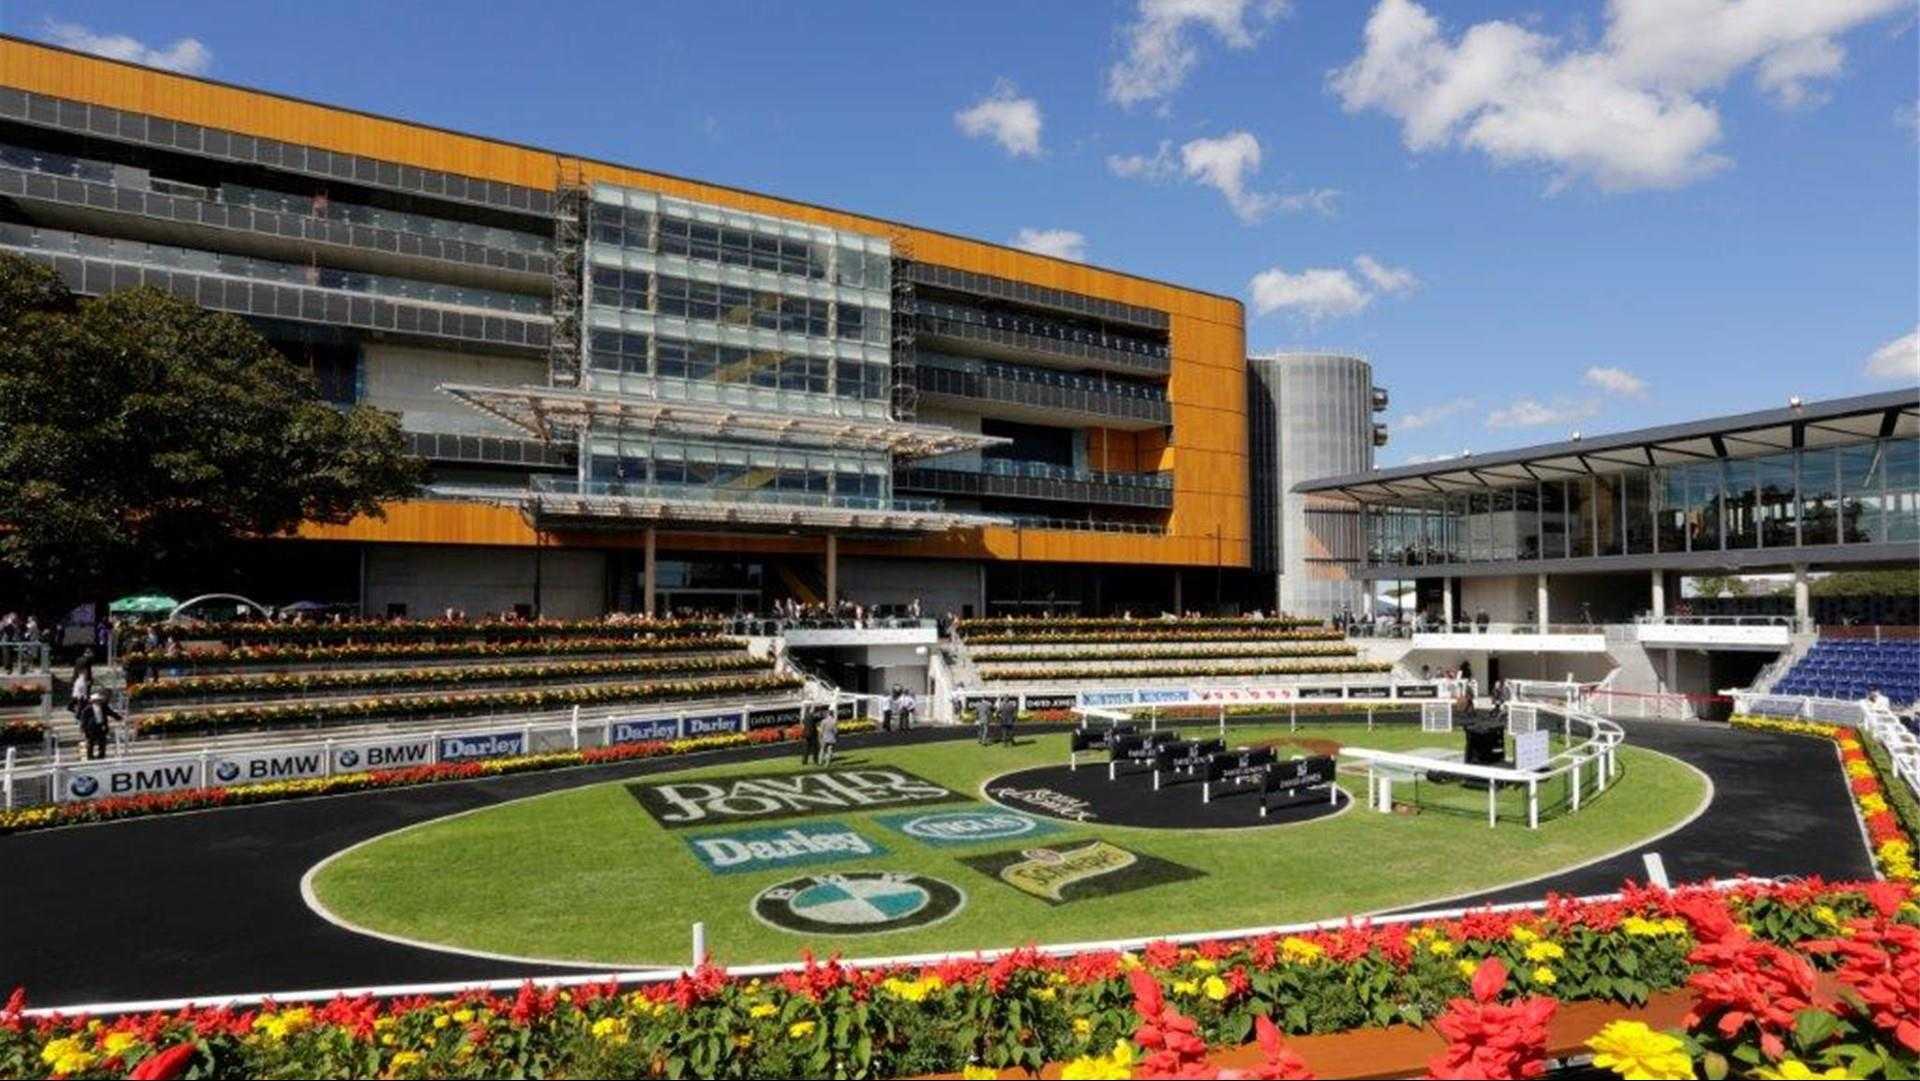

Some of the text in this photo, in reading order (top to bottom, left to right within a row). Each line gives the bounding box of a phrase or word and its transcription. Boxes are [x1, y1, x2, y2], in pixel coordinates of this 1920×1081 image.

[616, 723, 676, 742] Darley
[691, 716, 735, 733] Darley
[367, 743, 429, 765] BMW
[443, 736, 522, 759] Darley
[111, 765, 194, 793] BMW
[249, 754, 320, 779] BMW
[652, 770, 906, 801] DAVID
[663, 783, 949, 822] JONES
[694, 830, 873, 867] Darley
